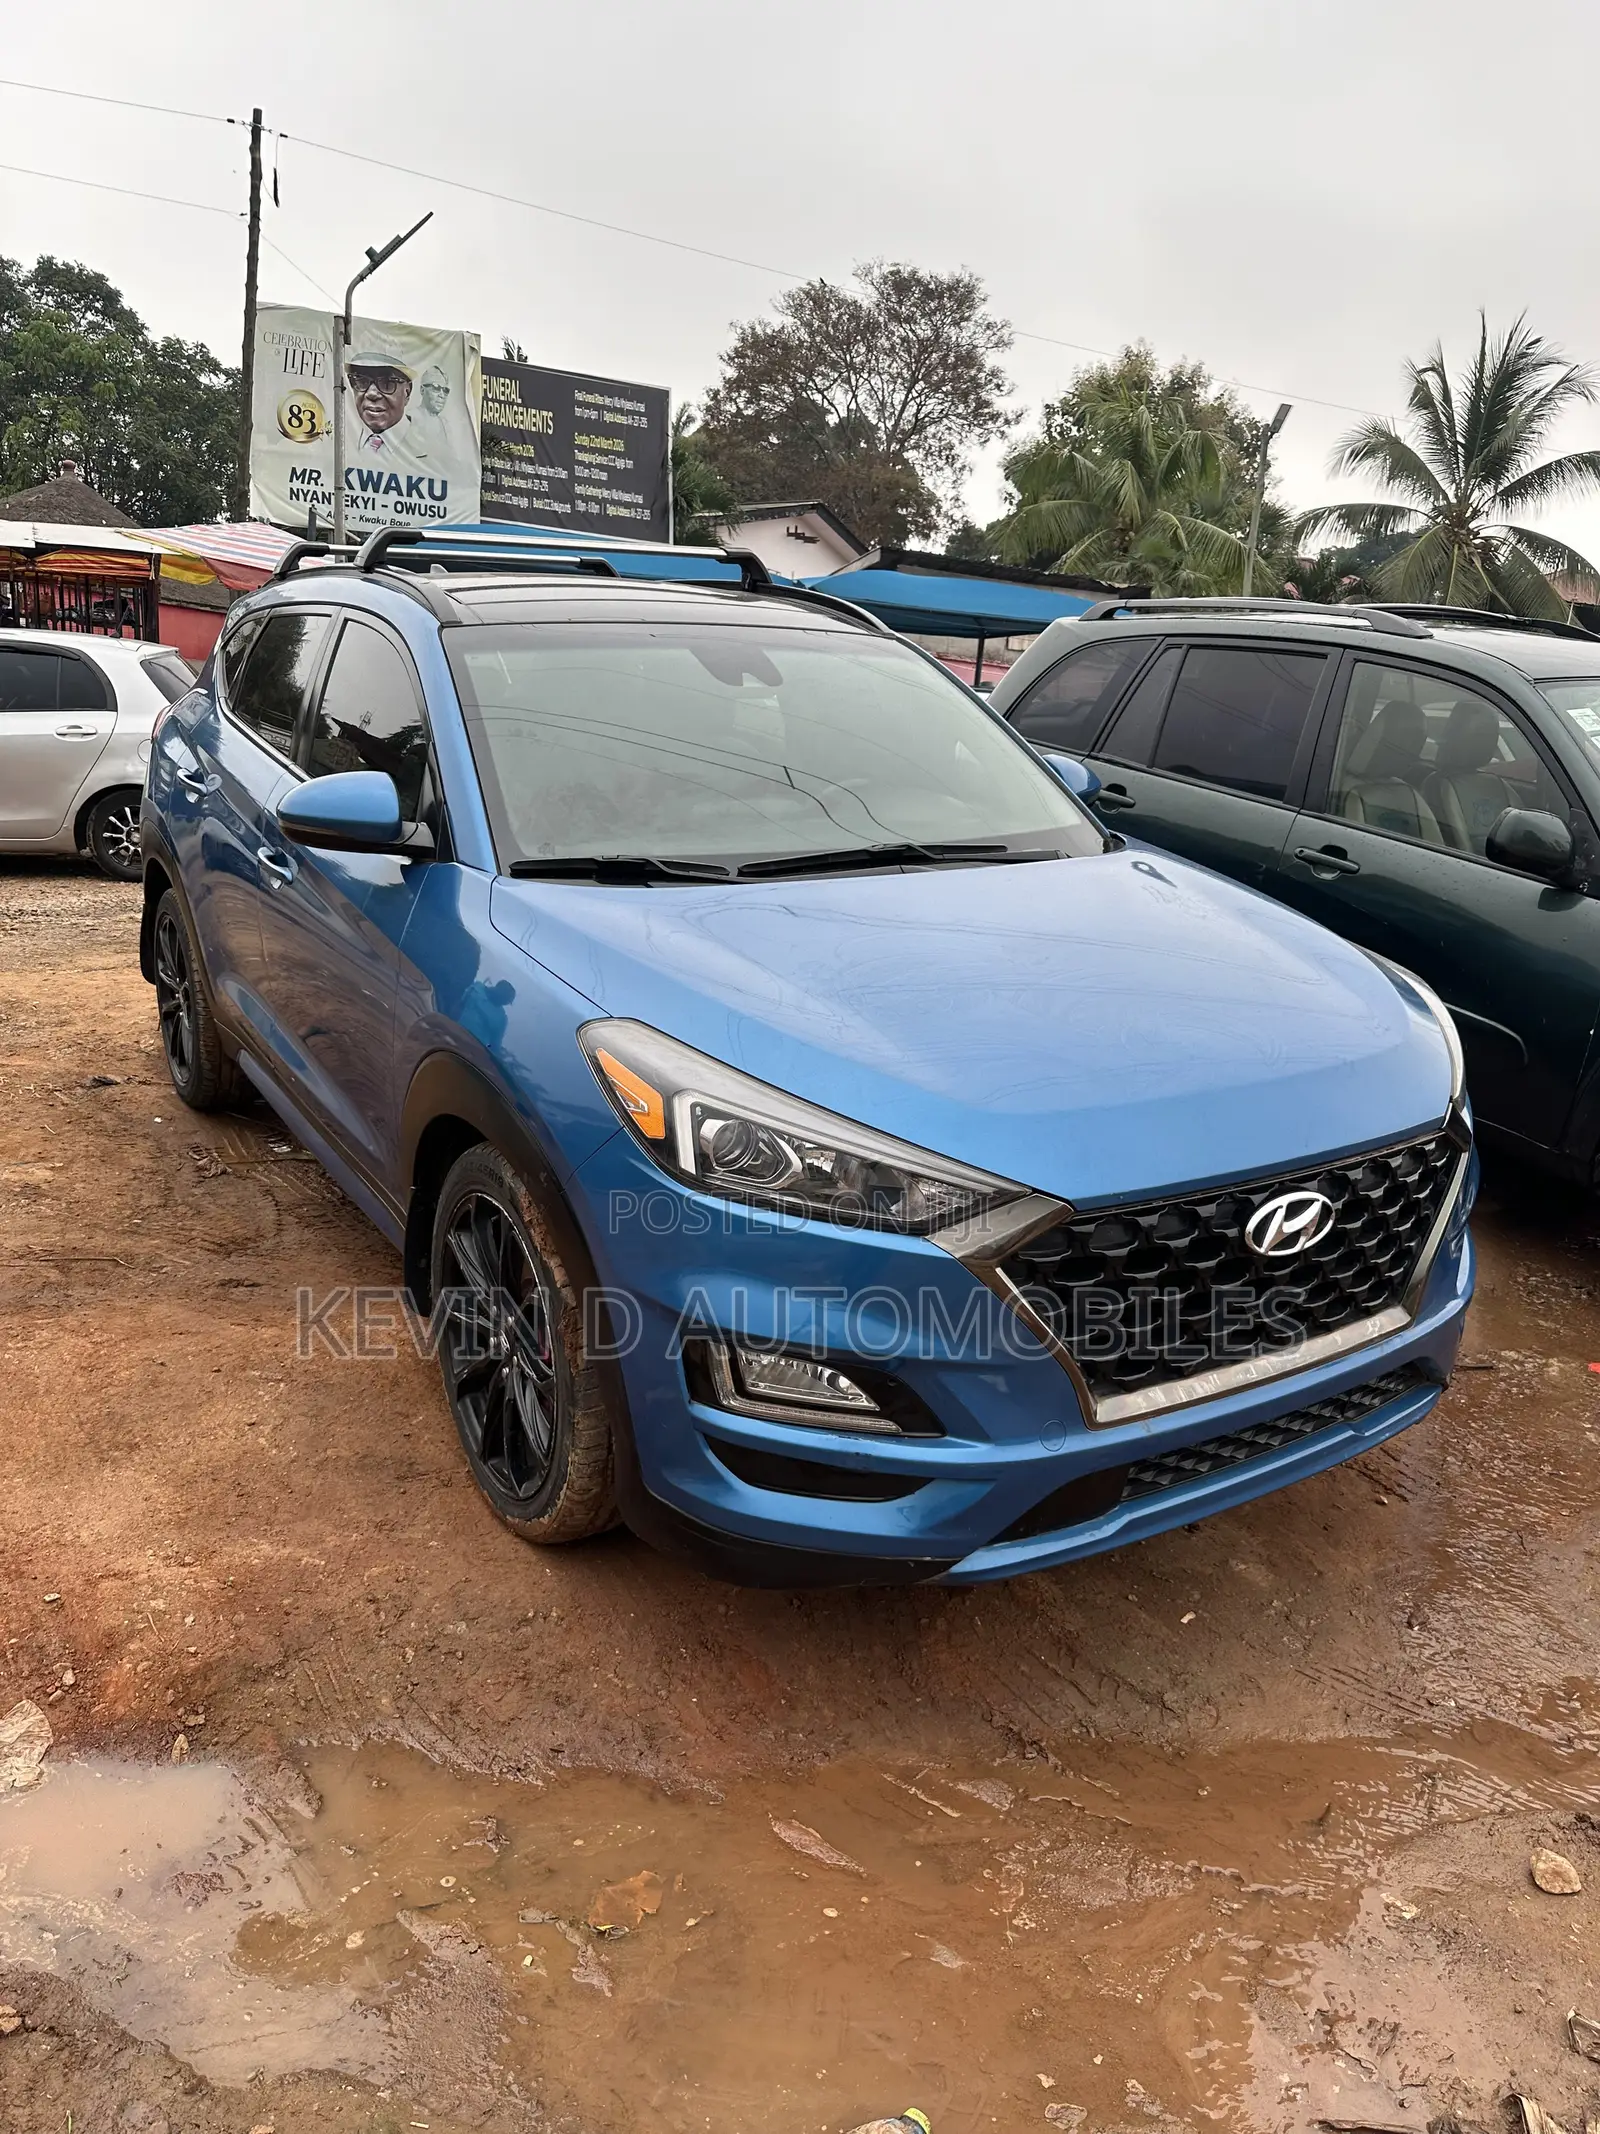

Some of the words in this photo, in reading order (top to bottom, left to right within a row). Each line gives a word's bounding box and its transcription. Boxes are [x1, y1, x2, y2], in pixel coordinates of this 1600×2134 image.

[282, 347, 326, 379] LIFE
[482, 374, 522, 404] FUNERAL
[287, 404, 317, 435] 83
[482, 400, 554, 435] ARRANGEMENTS
[289, 466, 325, 488] MR.
[289, 487, 376, 511] NYANEKYI
[394, 500, 447, 519] OWUSU
[359, 514, 387, 526] Kwaku
